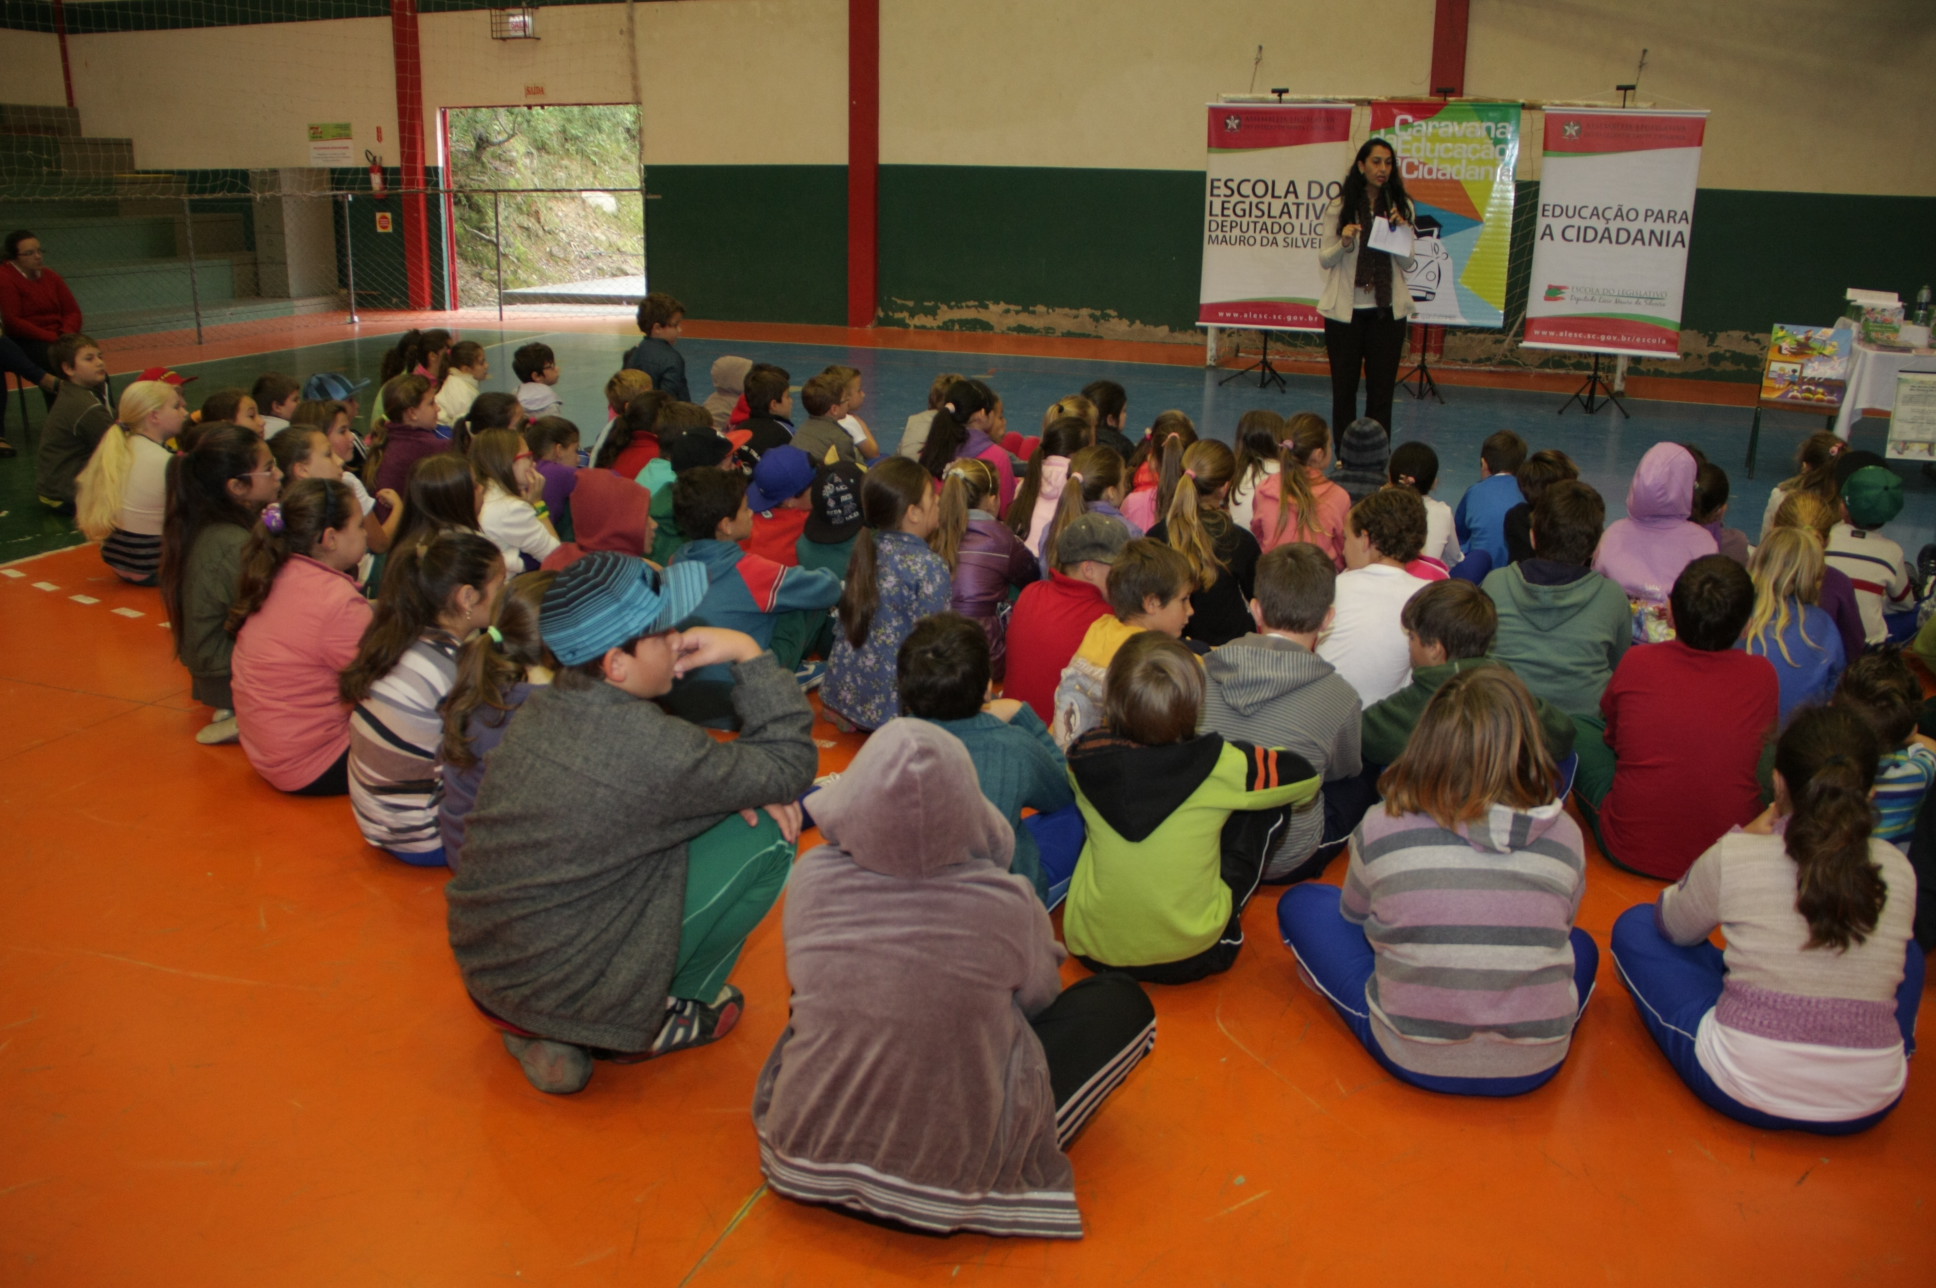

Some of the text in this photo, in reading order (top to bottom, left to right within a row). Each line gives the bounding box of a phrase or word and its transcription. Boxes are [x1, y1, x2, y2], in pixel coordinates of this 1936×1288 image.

[1394, 115, 1511, 138] Caravana
[1396, 135, 1509, 162] Educação
[1209, 178, 1344, 201] ESCOLA DO
[1208, 200, 1326, 220] LEGISLATIV
[1541, 203, 1690, 225] EDUCAÇÃO PARA
[1207, 219, 1324, 236] DEPUTADO LÍC
[1540, 224, 1687, 249] A CIDADANIA
[1207, 234, 1322, 249] MAURO DA SILVEI
[1218, 311, 1319, 322] www.alesc.sc.gov.br
[1533, 329, 1667, 345] www.alesc.sc.gov.br/escola
